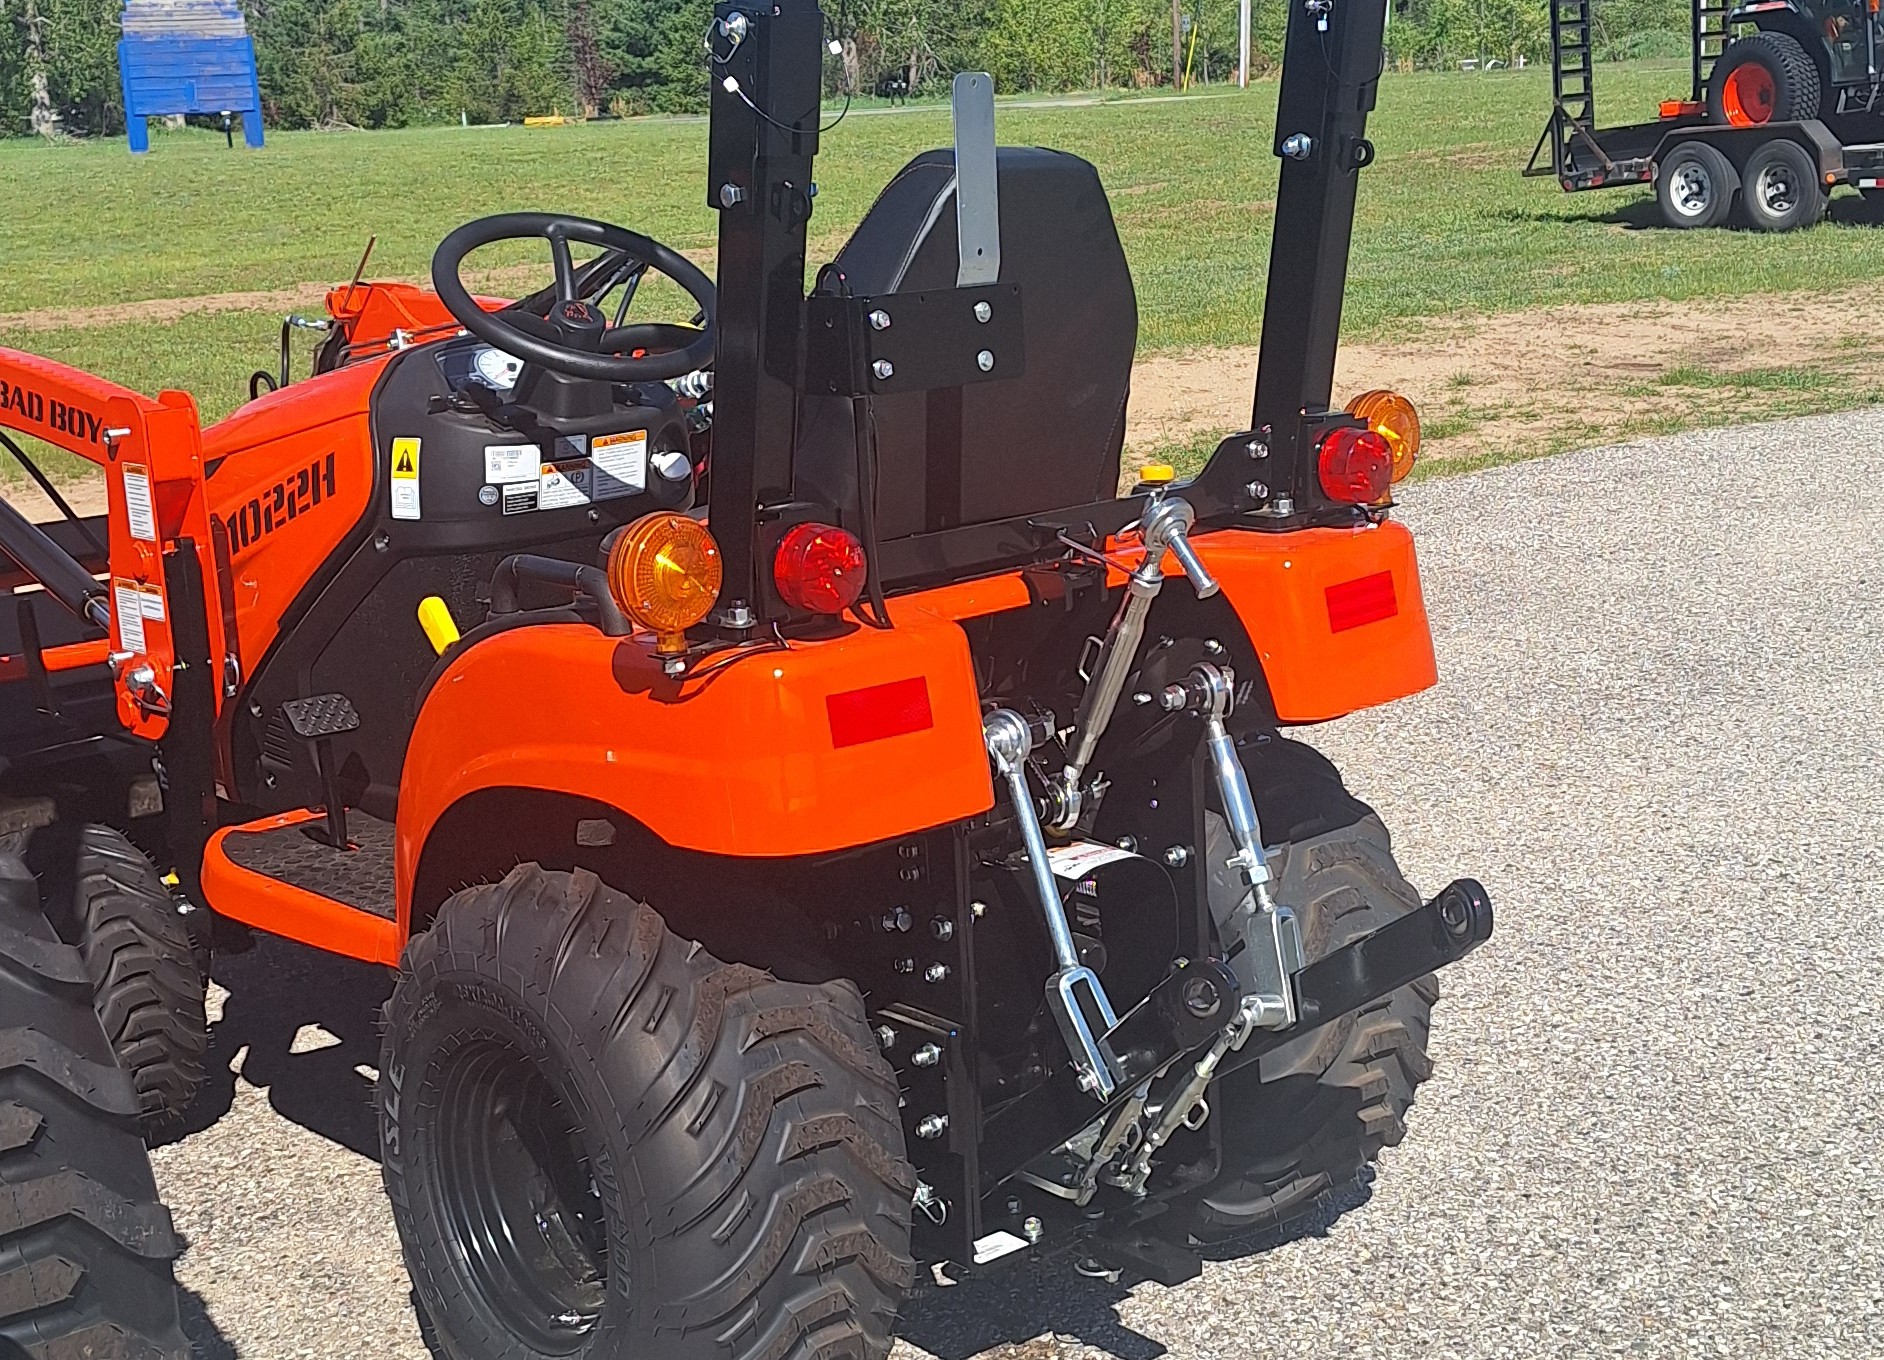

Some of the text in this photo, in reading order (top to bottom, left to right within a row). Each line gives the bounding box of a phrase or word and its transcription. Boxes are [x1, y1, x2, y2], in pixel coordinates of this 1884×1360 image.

[0, 380, 103, 444] BAD BOY
[226, 452, 336, 555] 1022H
